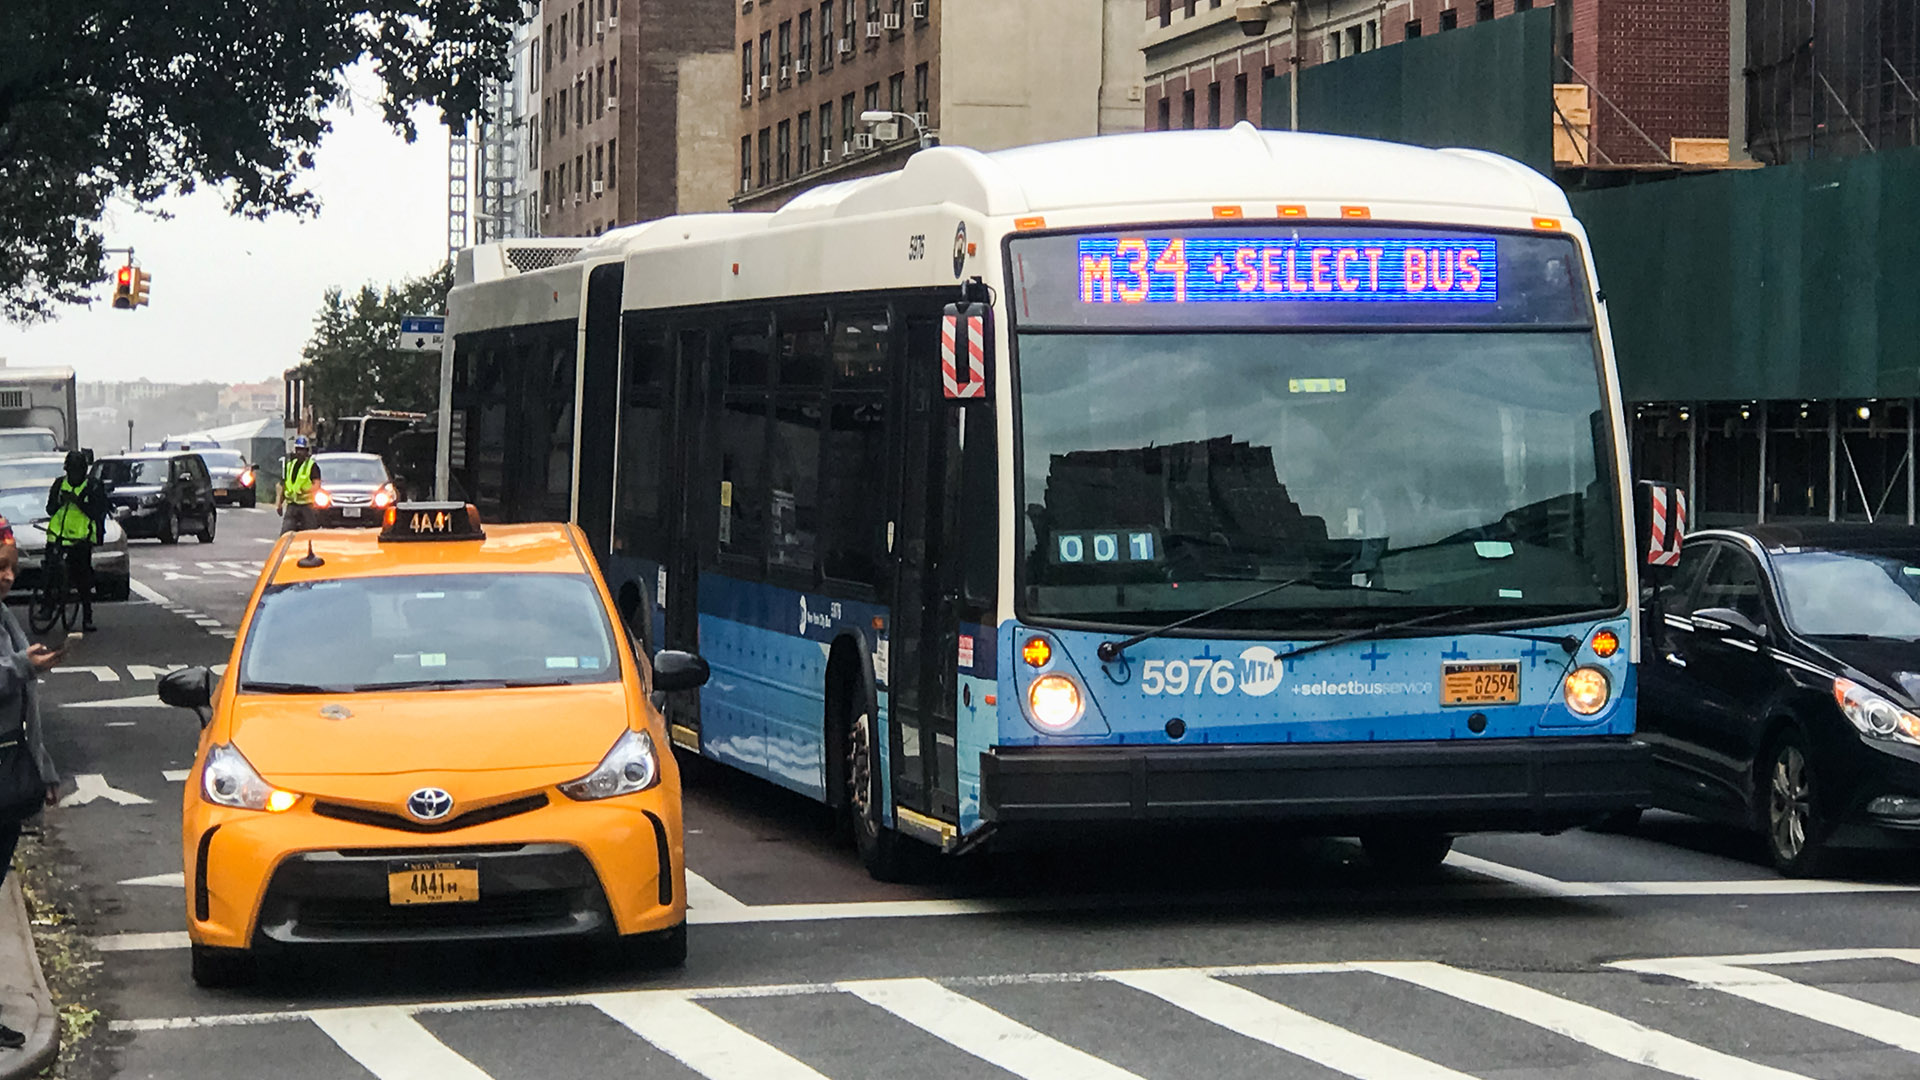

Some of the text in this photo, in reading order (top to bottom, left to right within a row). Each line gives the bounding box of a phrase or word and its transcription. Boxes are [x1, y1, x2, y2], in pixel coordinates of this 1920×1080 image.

[1405, 248, 1481, 292] BUS
[410, 511, 452, 533] 4A41
[1141, 659, 1235, 696] 5976
[1241, 658, 1275, 687] MTA
[1484, 674, 1516, 695] 2594
